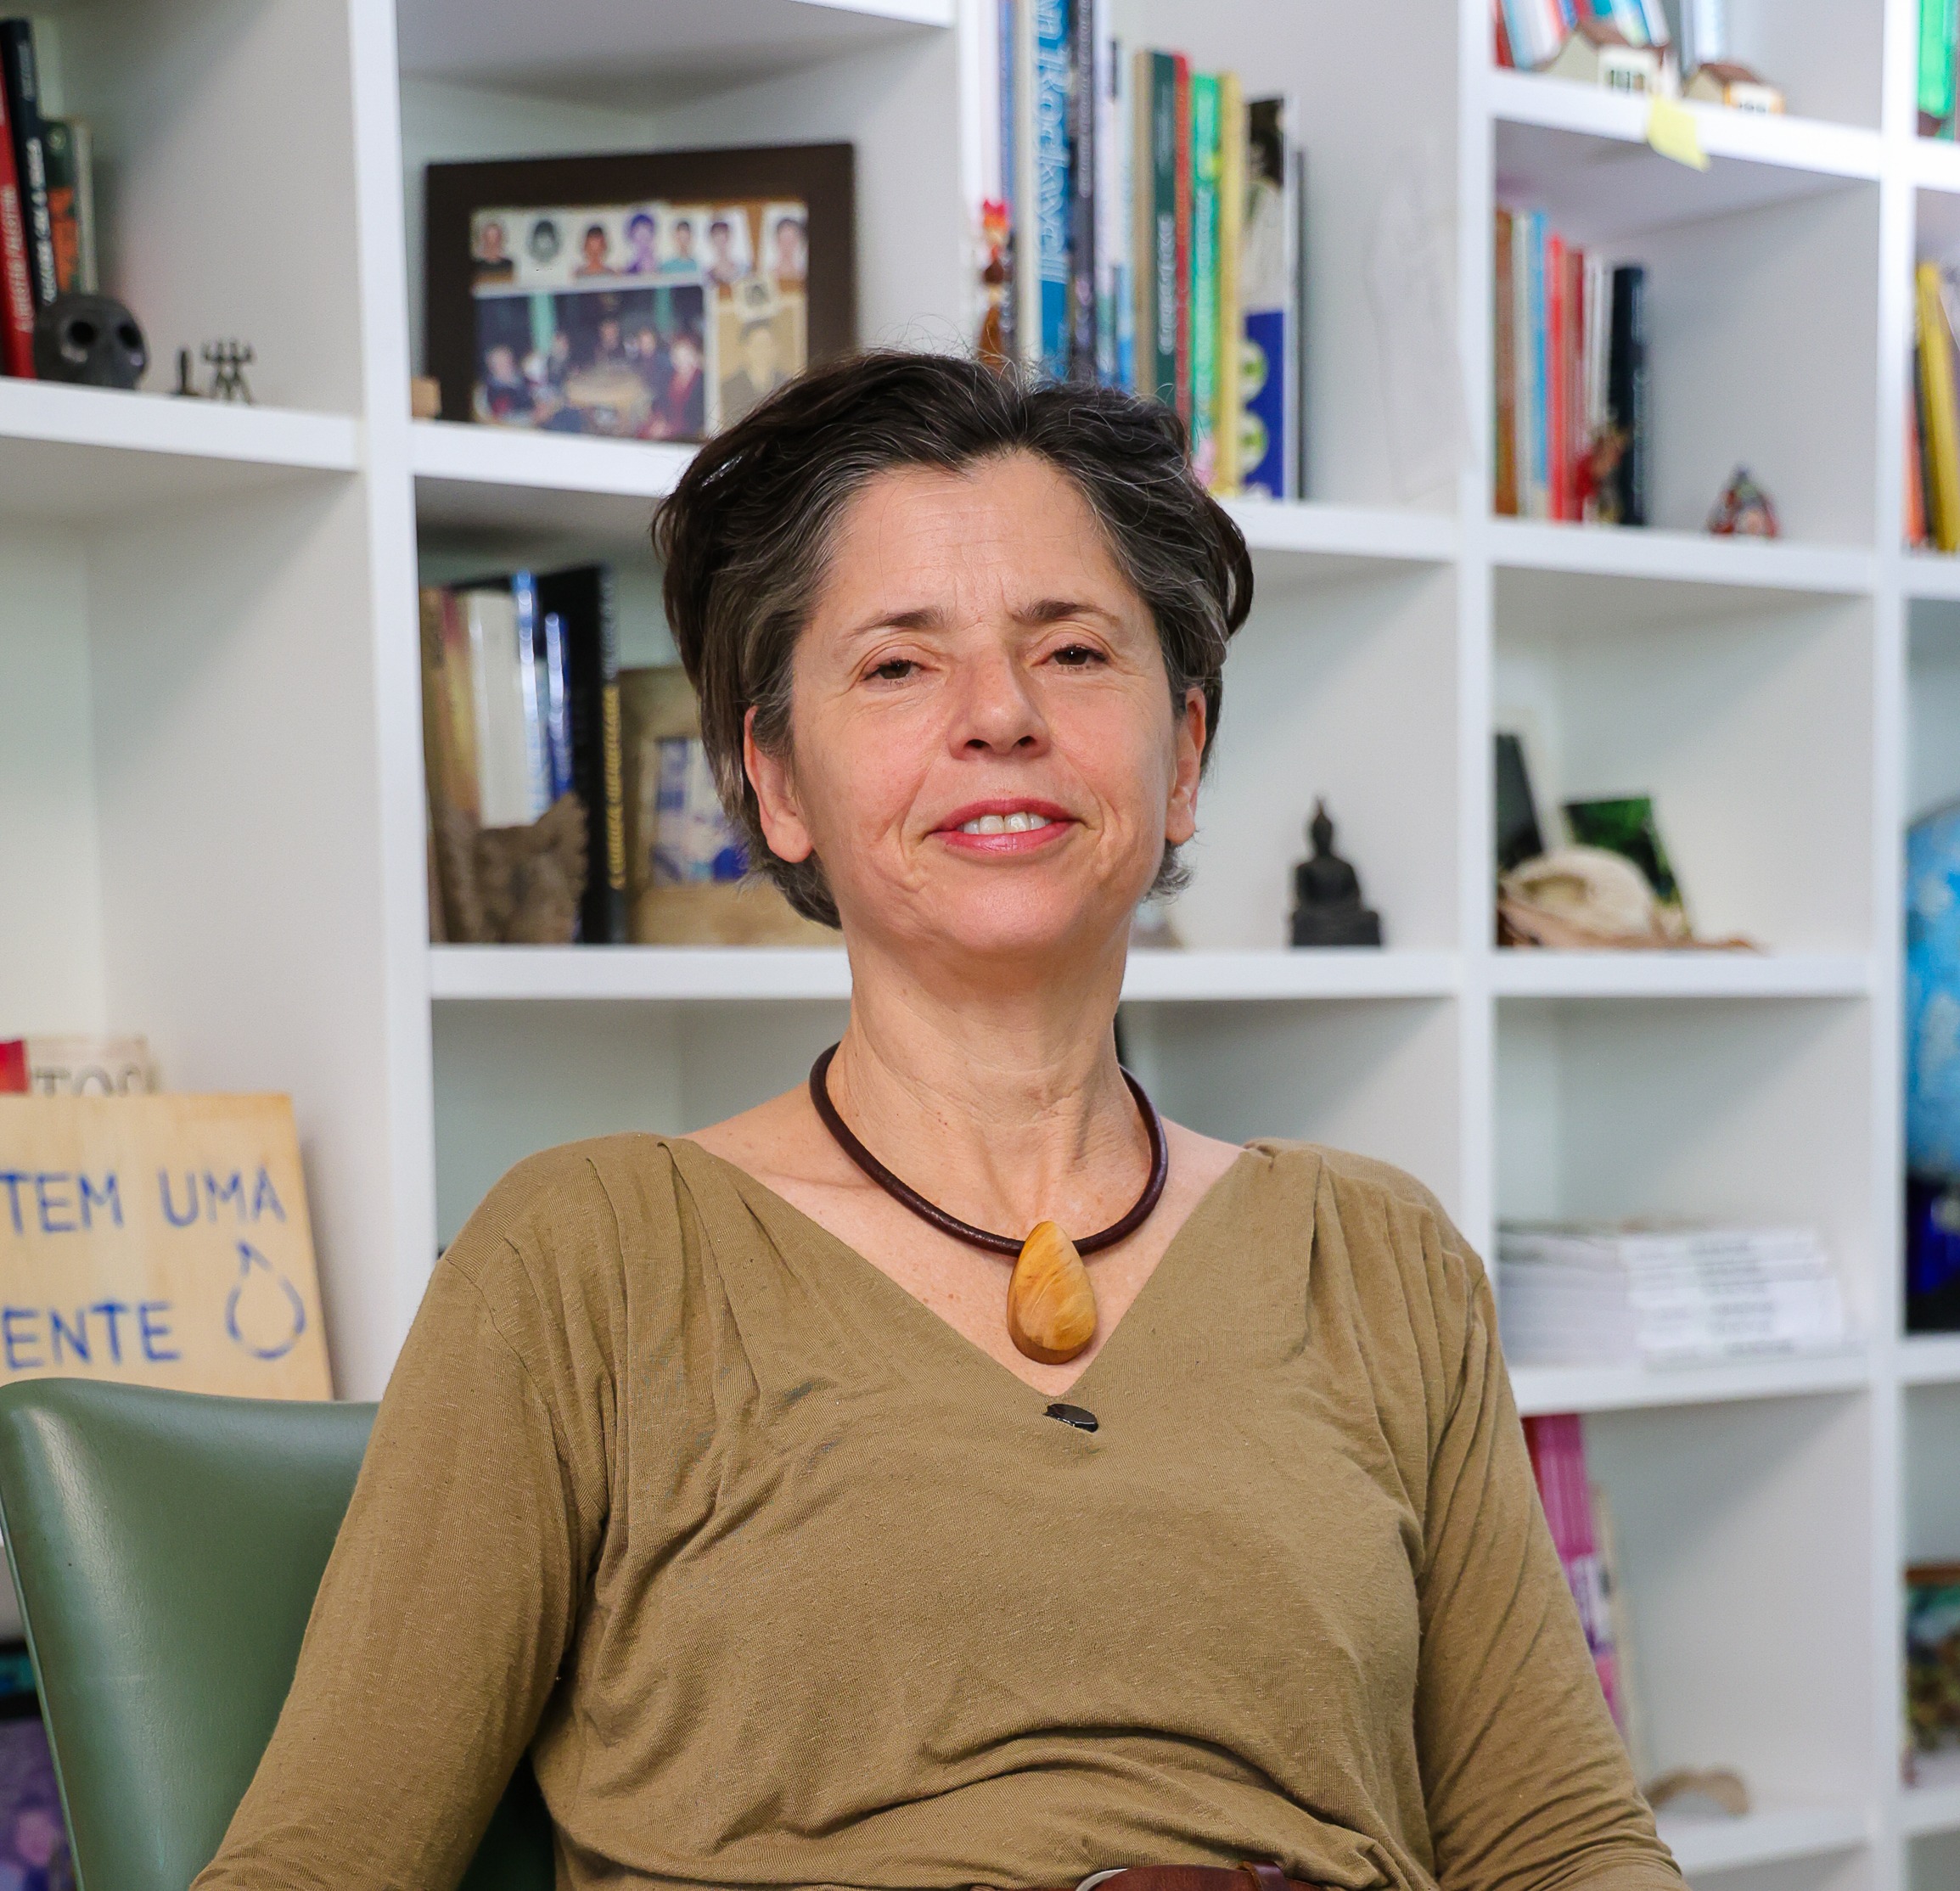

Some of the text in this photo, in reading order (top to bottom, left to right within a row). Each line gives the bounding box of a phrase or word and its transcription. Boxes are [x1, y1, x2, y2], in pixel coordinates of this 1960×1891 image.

[0, 1162, 287, 1234] TEM UMA
[1, 1299, 182, 1371] ENTE
